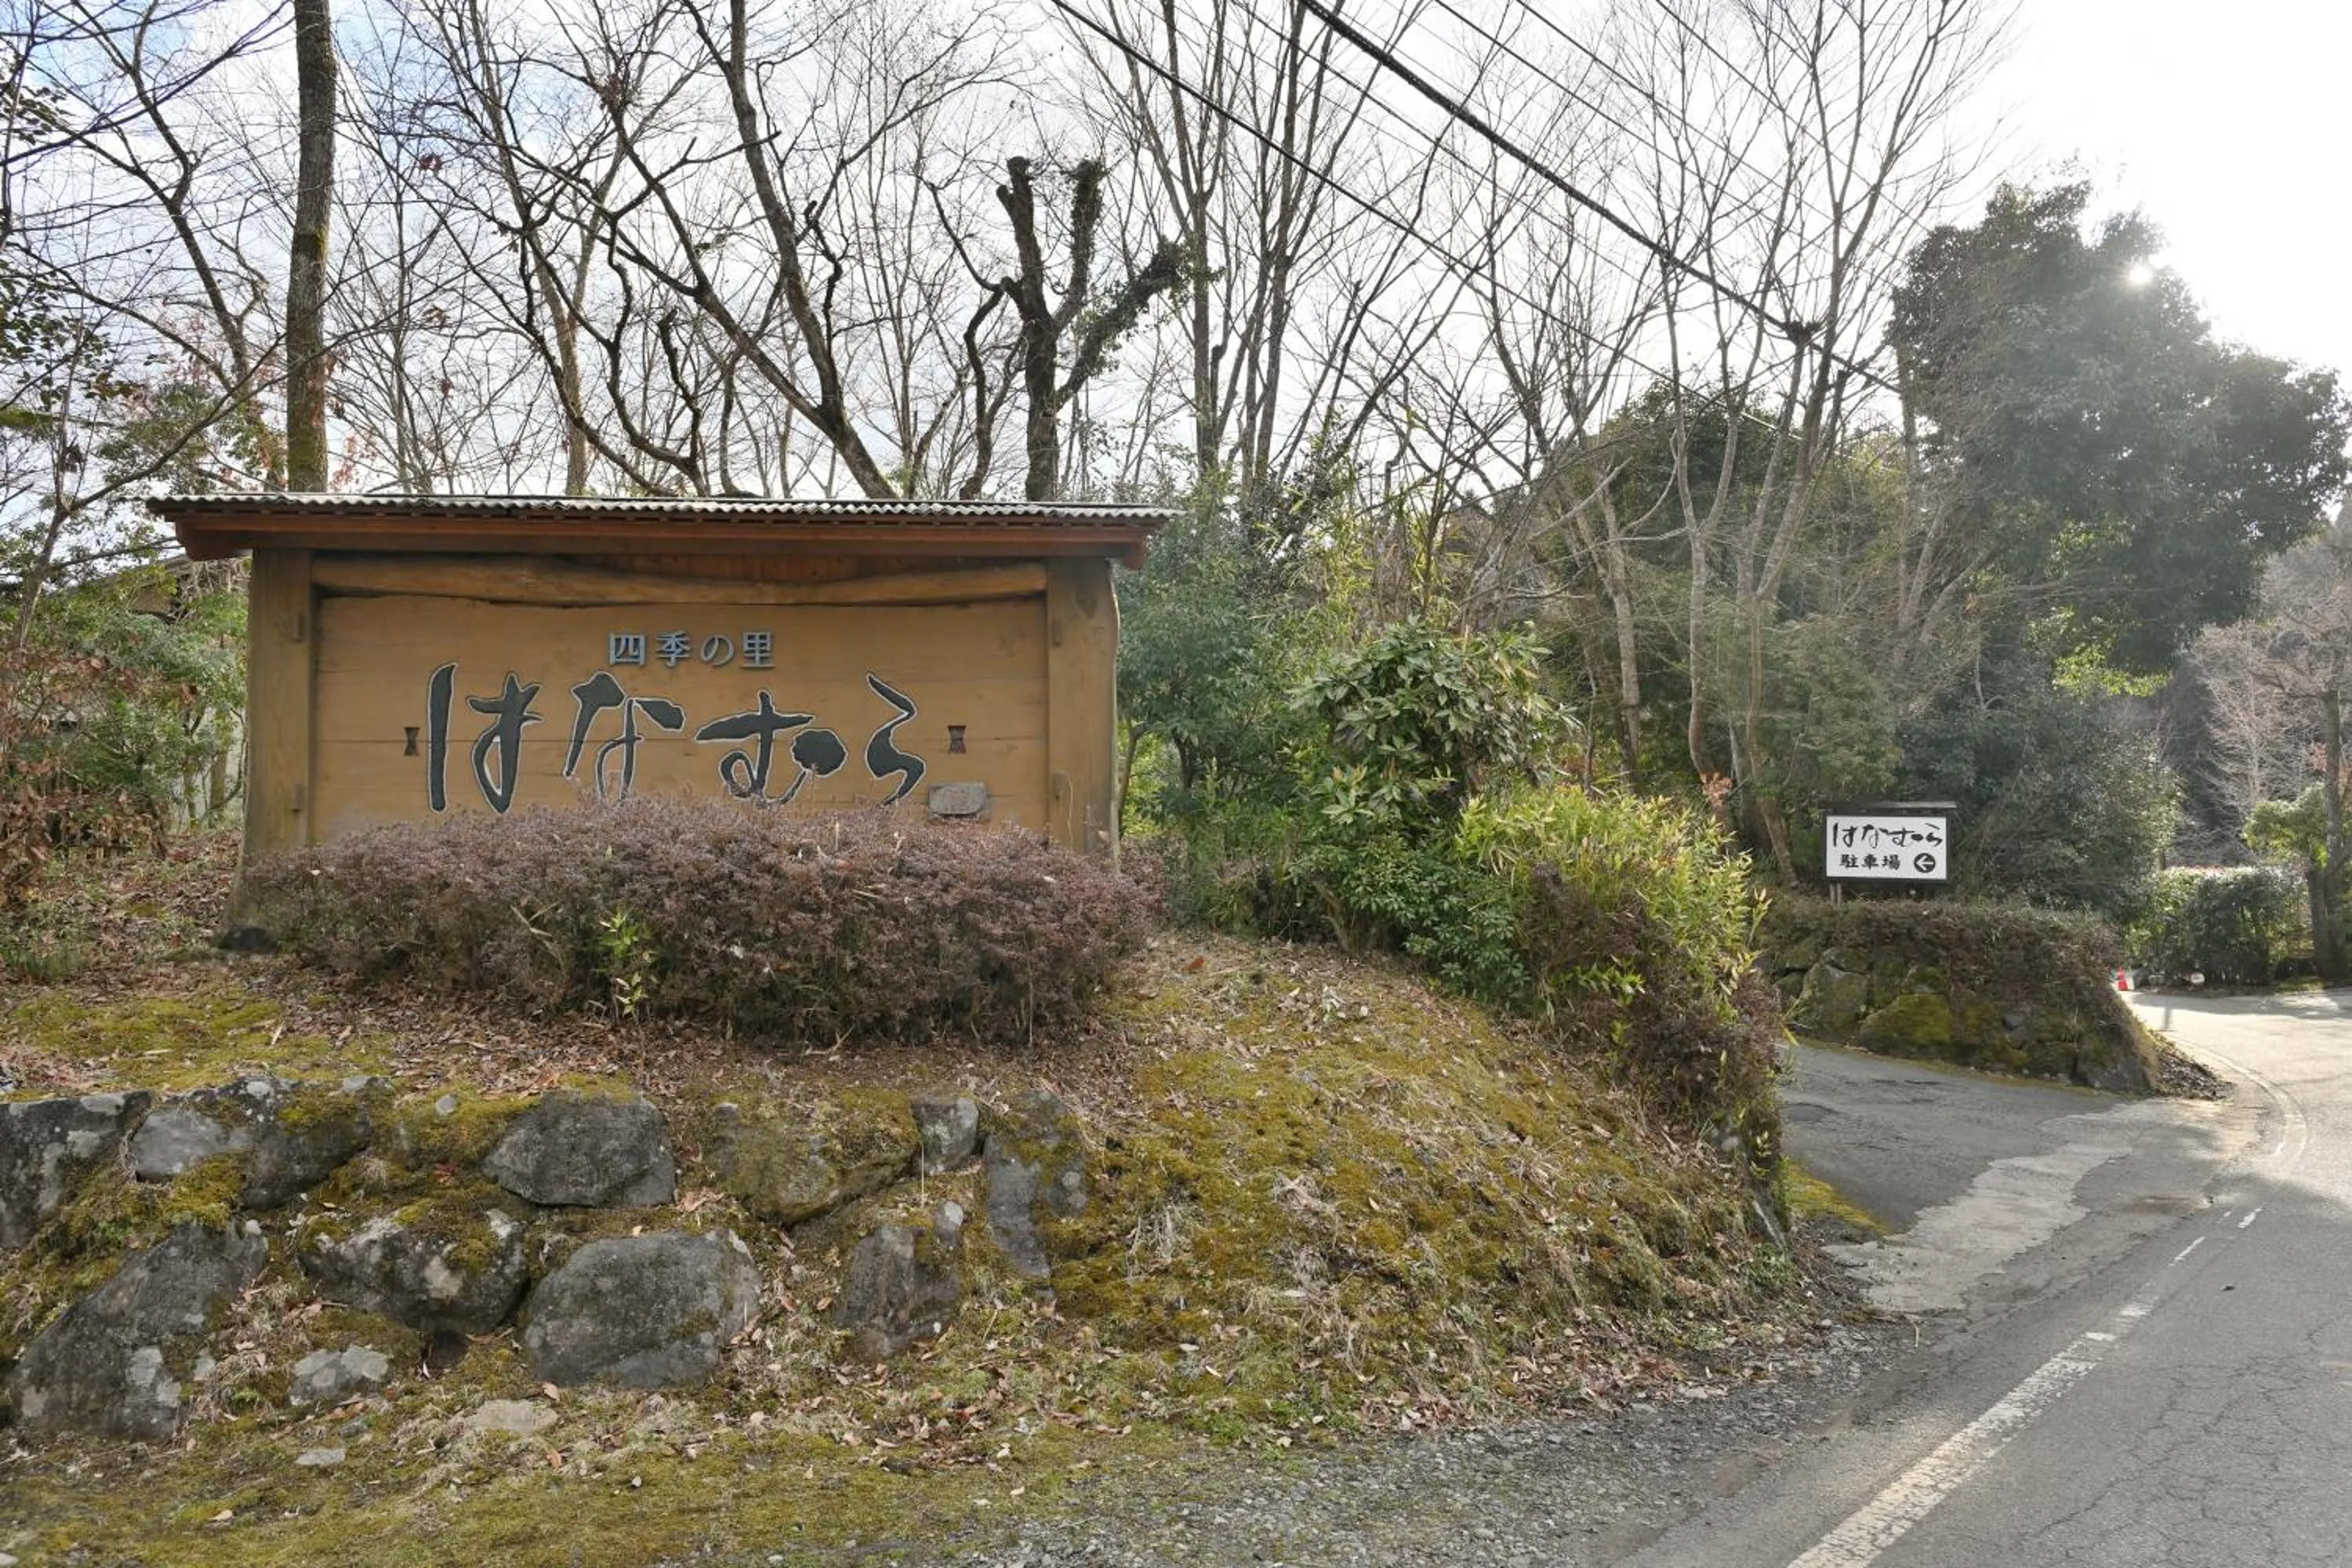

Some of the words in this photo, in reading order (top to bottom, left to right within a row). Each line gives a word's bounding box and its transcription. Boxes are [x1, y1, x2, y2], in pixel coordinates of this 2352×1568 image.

[608, 631, 775, 669] 四季の里
[427, 663, 926, 814] はなむら
[1833, 822, 1943, 848] はなむら
[1839, 854, 1901, 870] 駐車場
